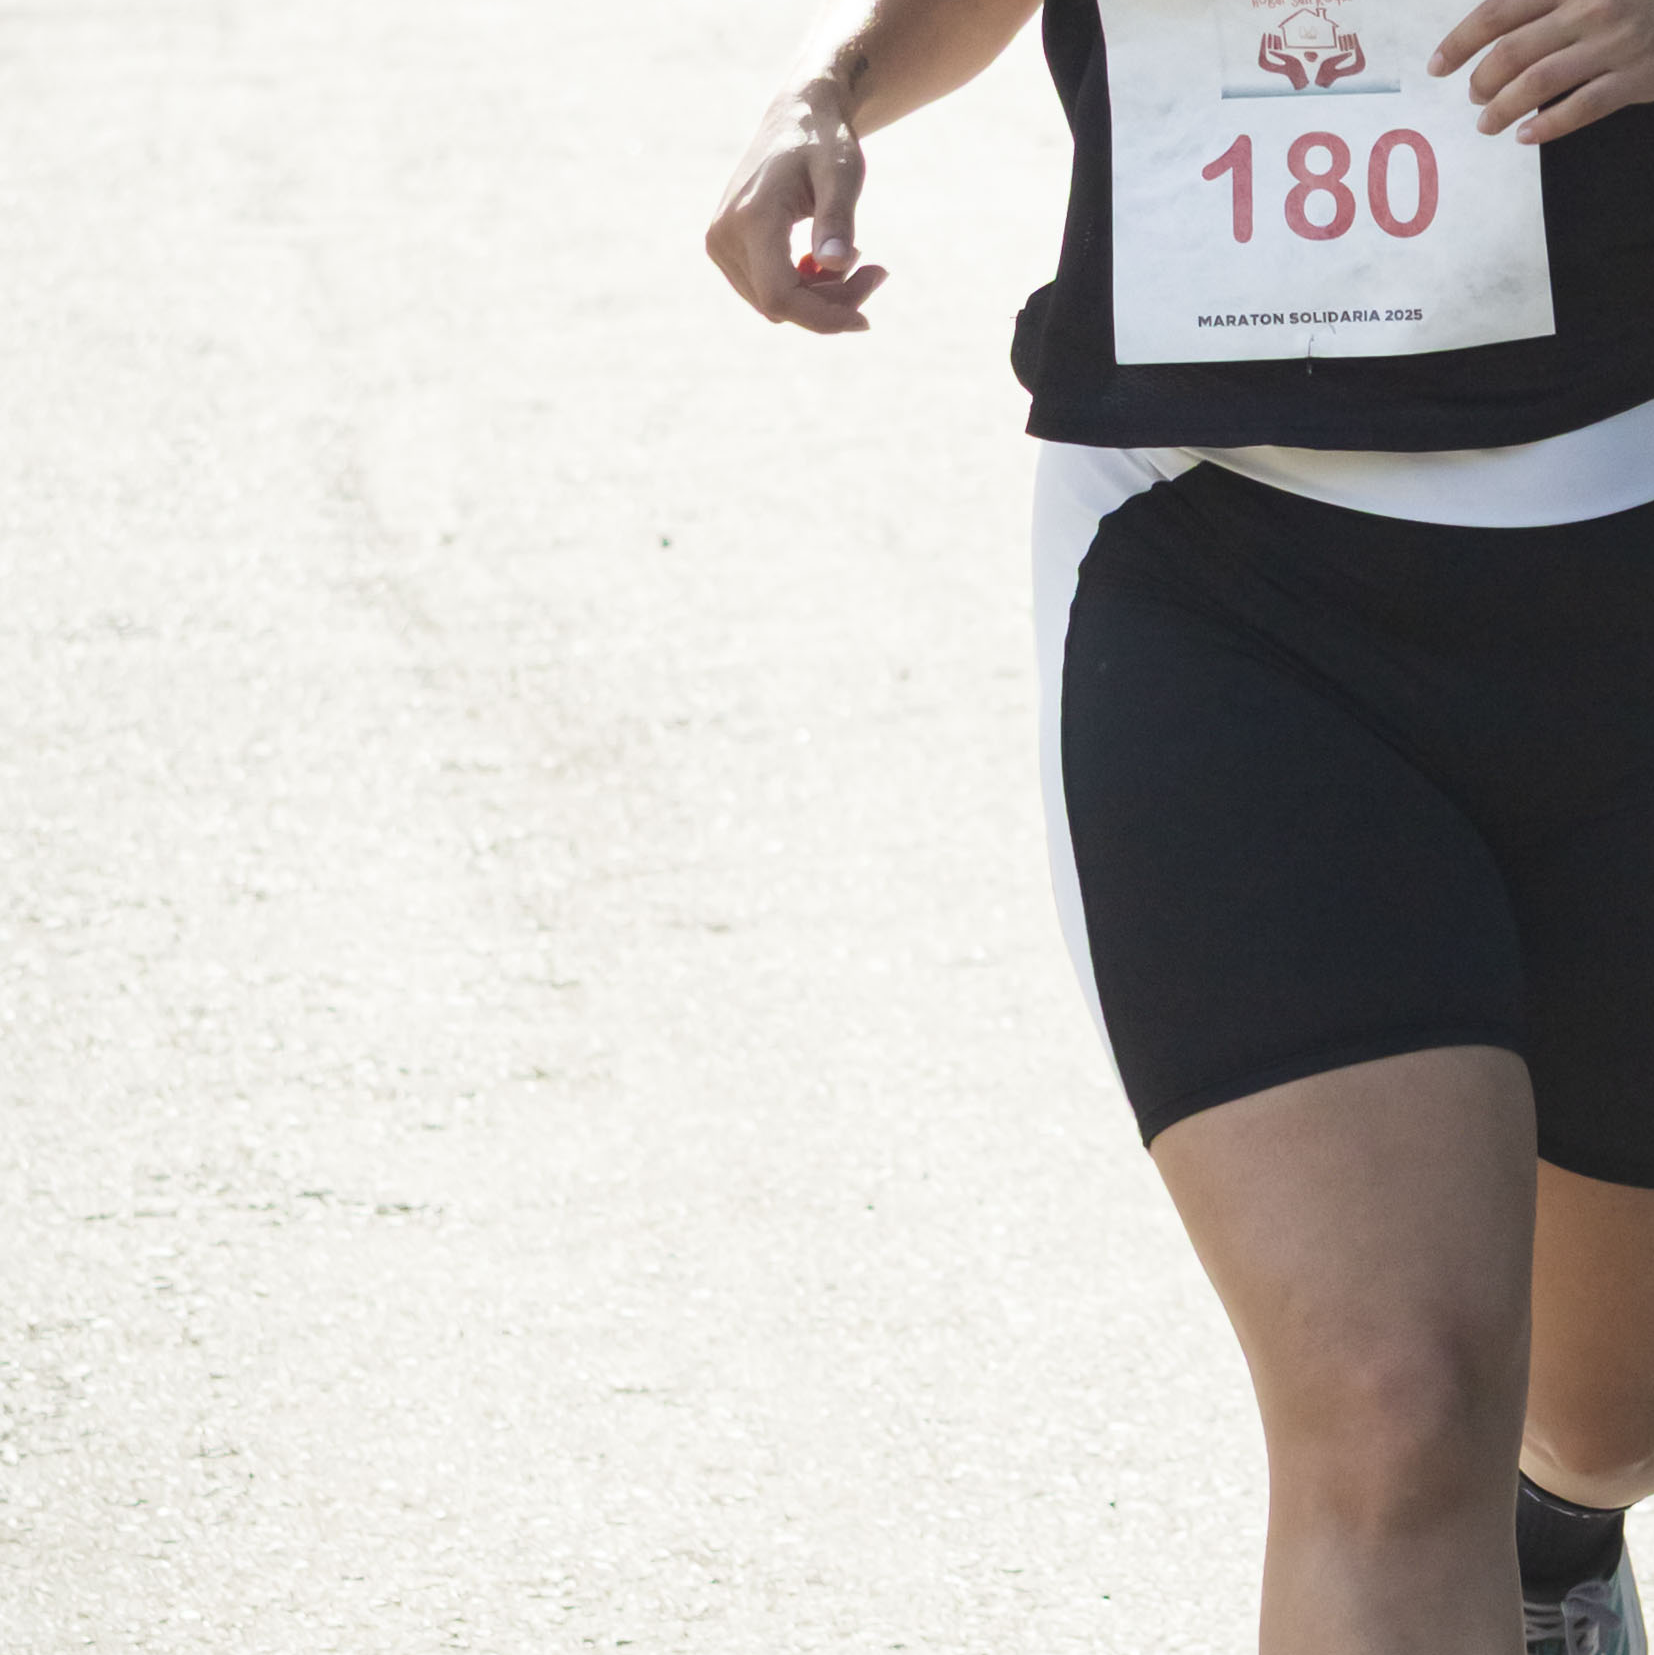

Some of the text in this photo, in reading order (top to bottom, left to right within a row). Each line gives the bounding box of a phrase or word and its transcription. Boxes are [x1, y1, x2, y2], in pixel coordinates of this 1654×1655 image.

[1201, 128, 1439, 244] 180
[1198, 308, 1424, 327] MARATON SOLIDARIA 2025
